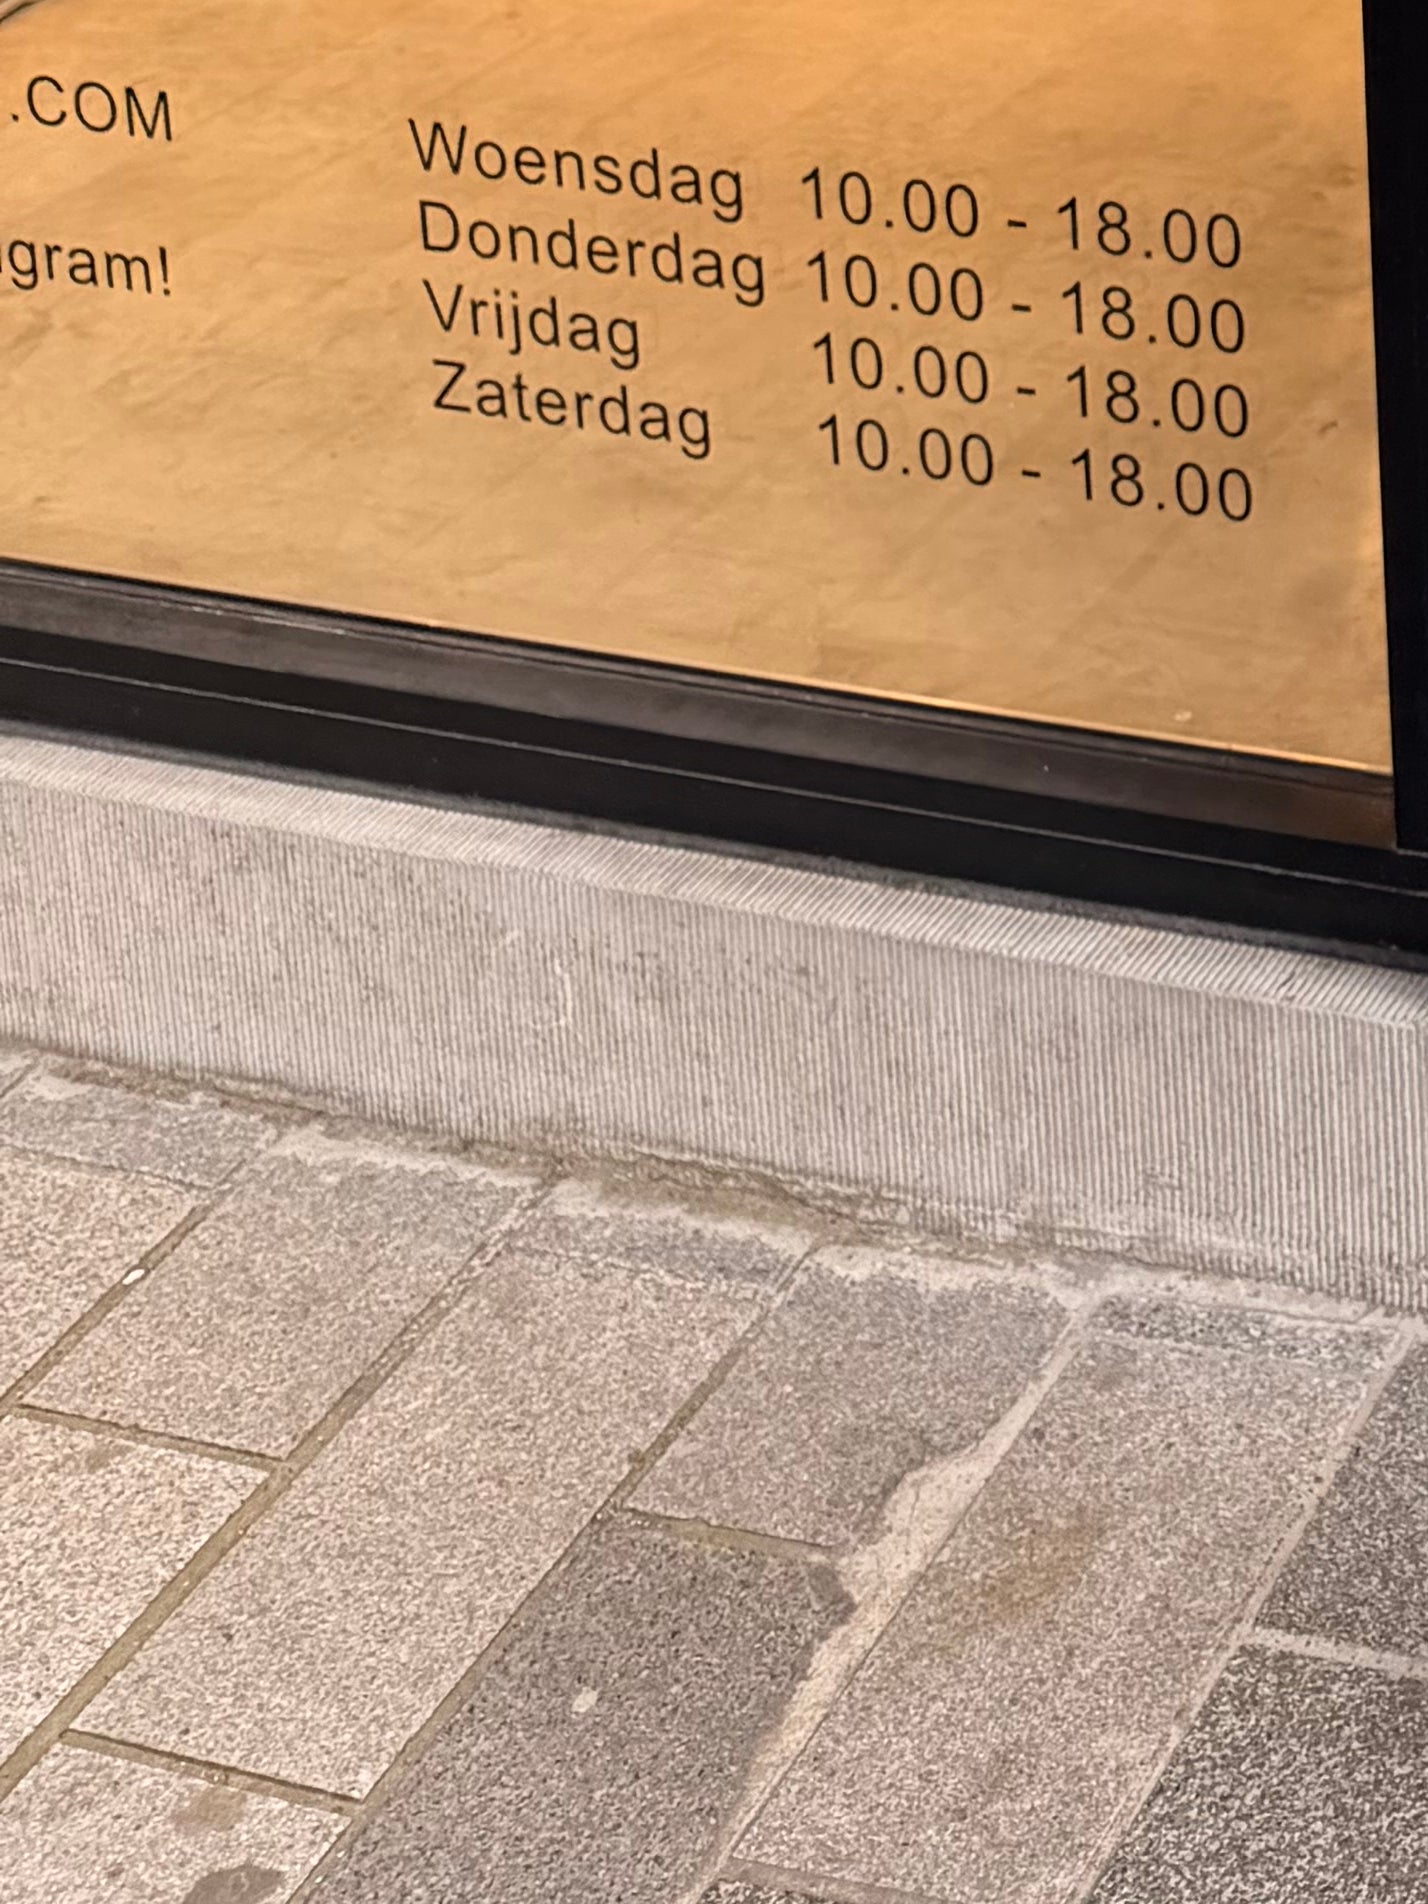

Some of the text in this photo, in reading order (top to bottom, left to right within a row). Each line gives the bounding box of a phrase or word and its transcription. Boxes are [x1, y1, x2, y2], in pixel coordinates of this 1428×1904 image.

[10, 74, 173, 143] .COM
[0, 239, 171, 297] gram!
[407, 117, 744, 224] Woensdag
[800, 165, 979, 239] 10.00
[1056, 195, 1242, 269] 18.00
[418, 199, 766, 308] Donderdag
[806, 249, 984, 322] 10.00
[1061, 280, 1245, 354] 18.00
[421, 278, 641, 372] Vrijdag
[812, 331, 989, 405] 10.00
[1066, 364, 1249, 439] 18.00
[431, 358, 712, 461] Zaterdag
[818, 413, 995, 487] 10.00
[1070, 447, 1253, 523] 18.00
